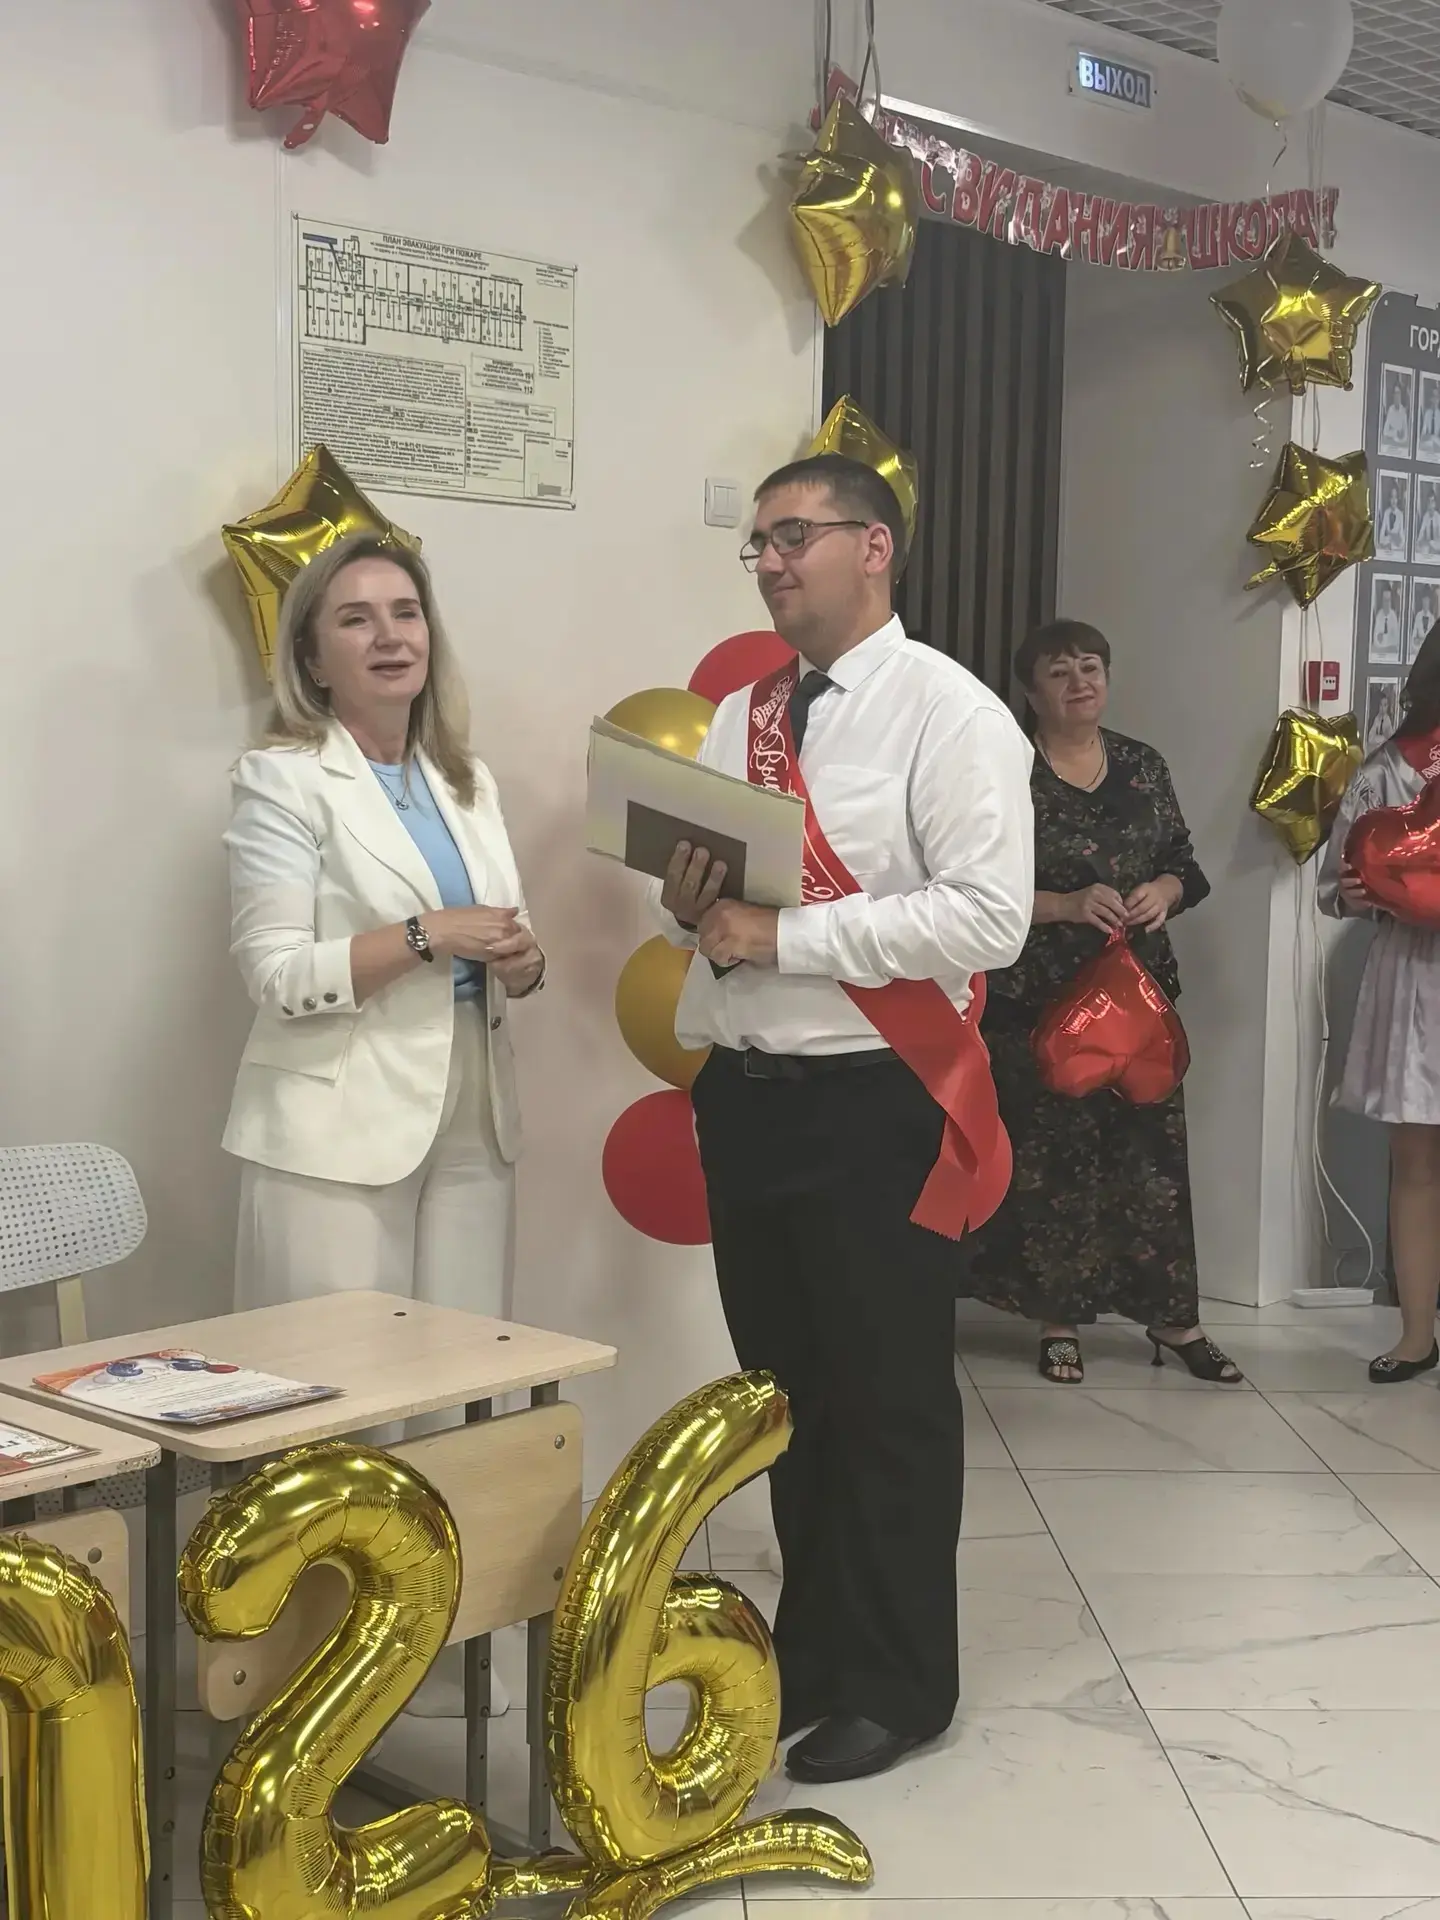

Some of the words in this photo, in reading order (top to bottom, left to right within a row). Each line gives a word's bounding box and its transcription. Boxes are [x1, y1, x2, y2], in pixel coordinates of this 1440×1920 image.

[1079, 57, 1147, 106] ВЫХОД
[383, 235, 402, 246] ПЛАН
[402, 239, 441, 253] ЭВАКУАЦИИ
[441, 246, 456, 256] ПРИ
[456, 248, 482, 261] ПОЖАРЕ
[1410, 324, 1440, 359] ГОР
